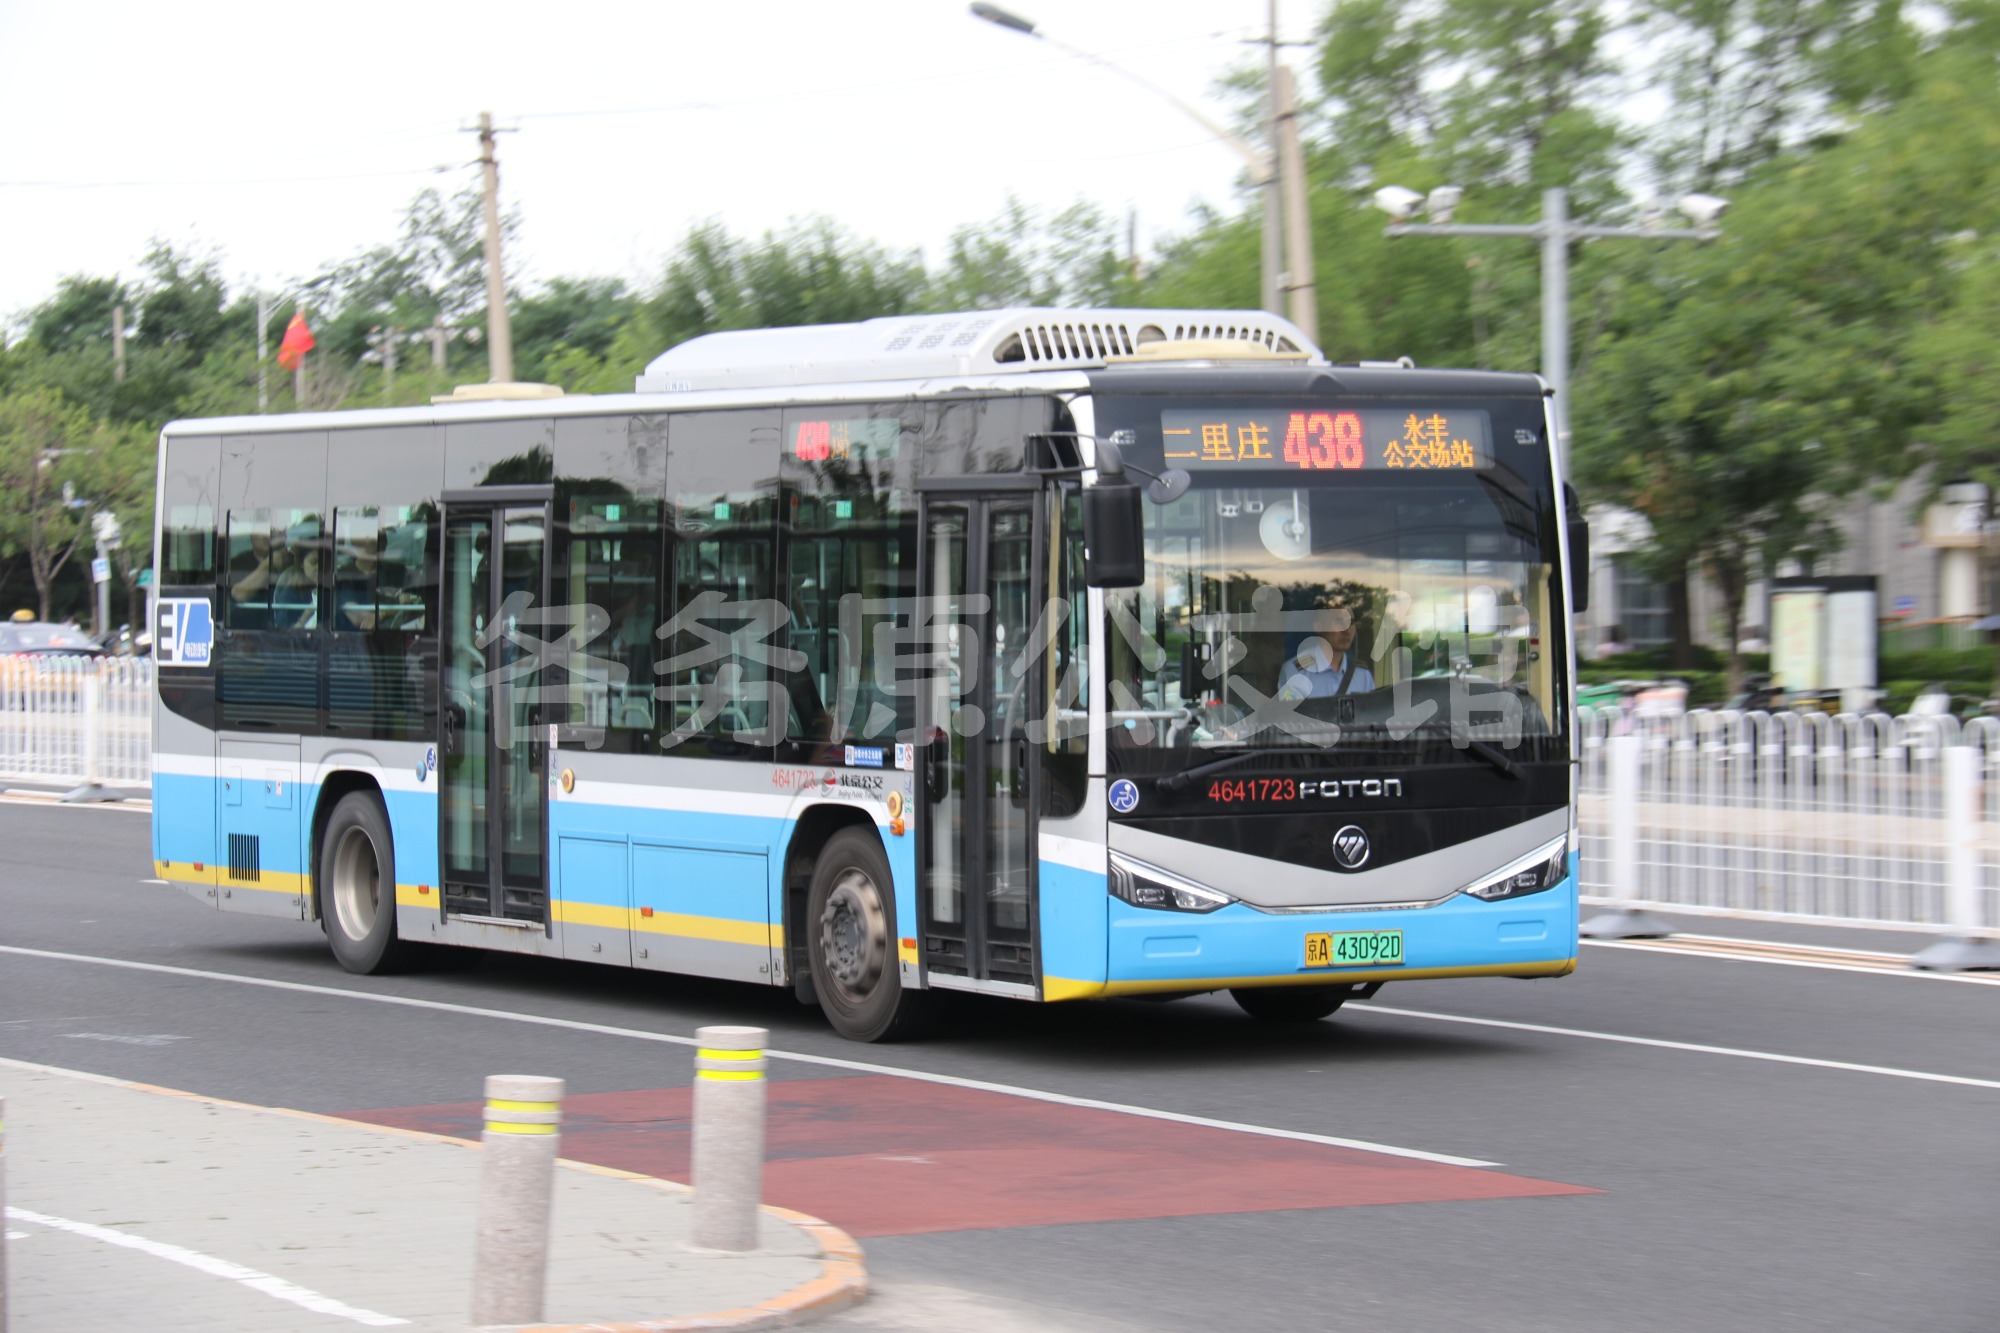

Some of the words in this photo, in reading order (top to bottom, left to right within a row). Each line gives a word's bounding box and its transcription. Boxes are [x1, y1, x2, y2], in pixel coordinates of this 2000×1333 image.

[1402, 413, 1448, 442] 永丰
[1163, 421, 1273, 462] 二里庄
[1283, 412, 1365, 469] 438
[1382, 440, 1475, 468] 公交场站
[771, 768, 817, 789] 4641723
[839, 773, 884, 789] 北京公交
[1208, 778, 1296, 801] 4641723
[1299, 778, 1402, 799] FOTON
[1307, 938, 1328, 961] 京A
[1337, 935, 1400, 960] 43092D
